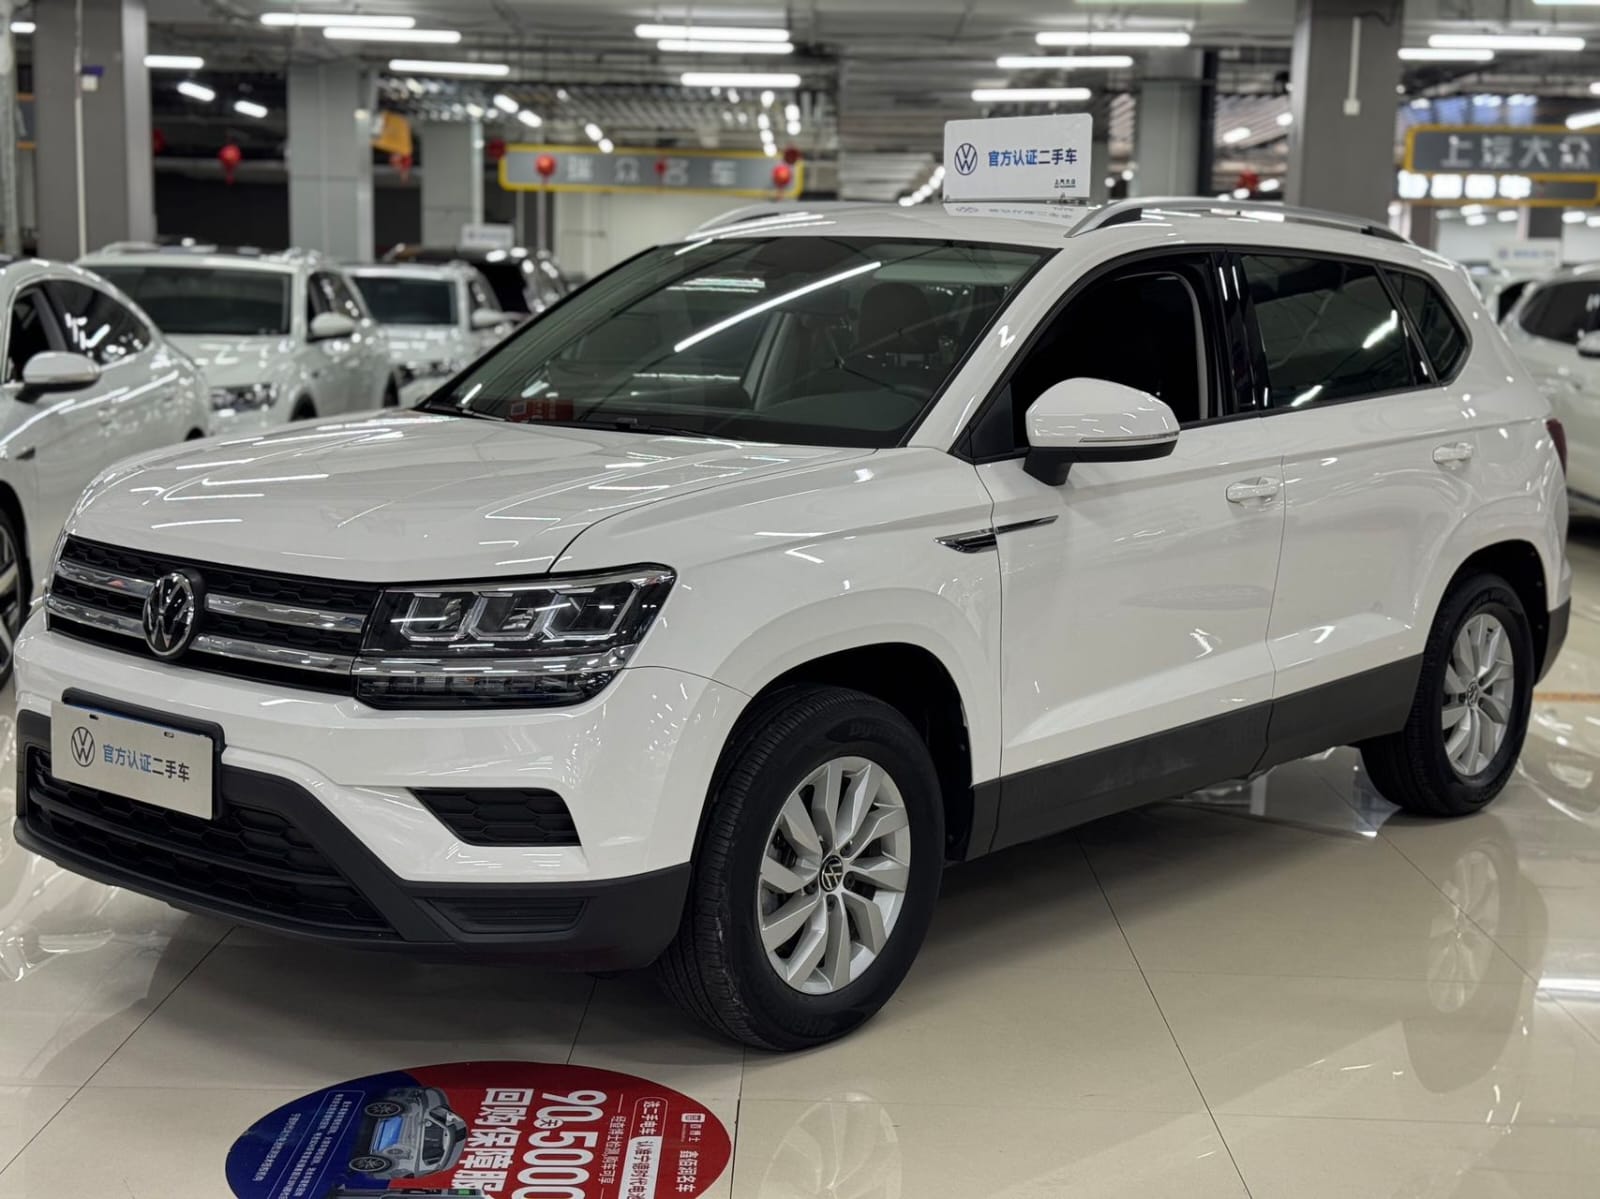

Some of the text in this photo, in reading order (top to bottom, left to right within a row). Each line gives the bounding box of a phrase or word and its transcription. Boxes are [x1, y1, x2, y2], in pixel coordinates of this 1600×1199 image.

[988, 148, 1078, 167] 官方认证二手车
[103, 743, 190, 782] 官方认证二手车
[451, 1088, 533, 1199] 回购保障服
